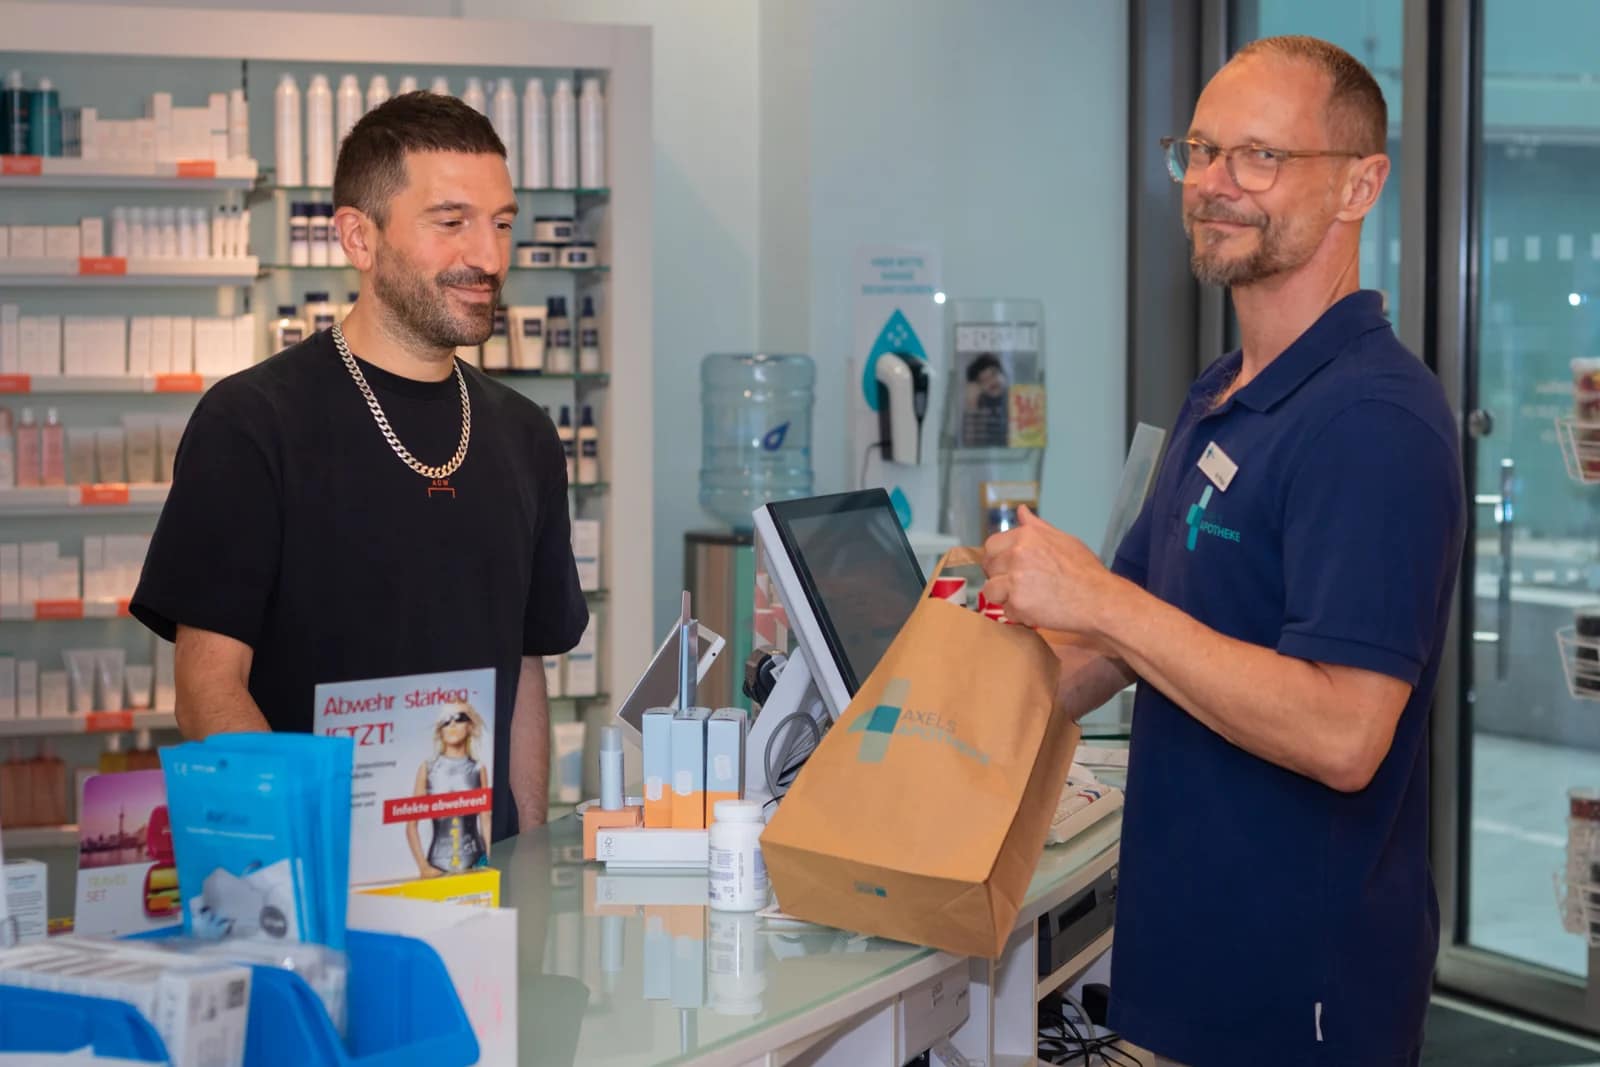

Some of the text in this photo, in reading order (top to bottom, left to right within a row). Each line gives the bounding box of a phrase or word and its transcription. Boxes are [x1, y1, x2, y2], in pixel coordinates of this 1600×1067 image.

[323, 693, 396, 716] Abwehr
[902, 709, 958, 734] AXELS
[392, 794, 487, 816] Infekte abwehren!
[86, 889, 107, 903] SET
